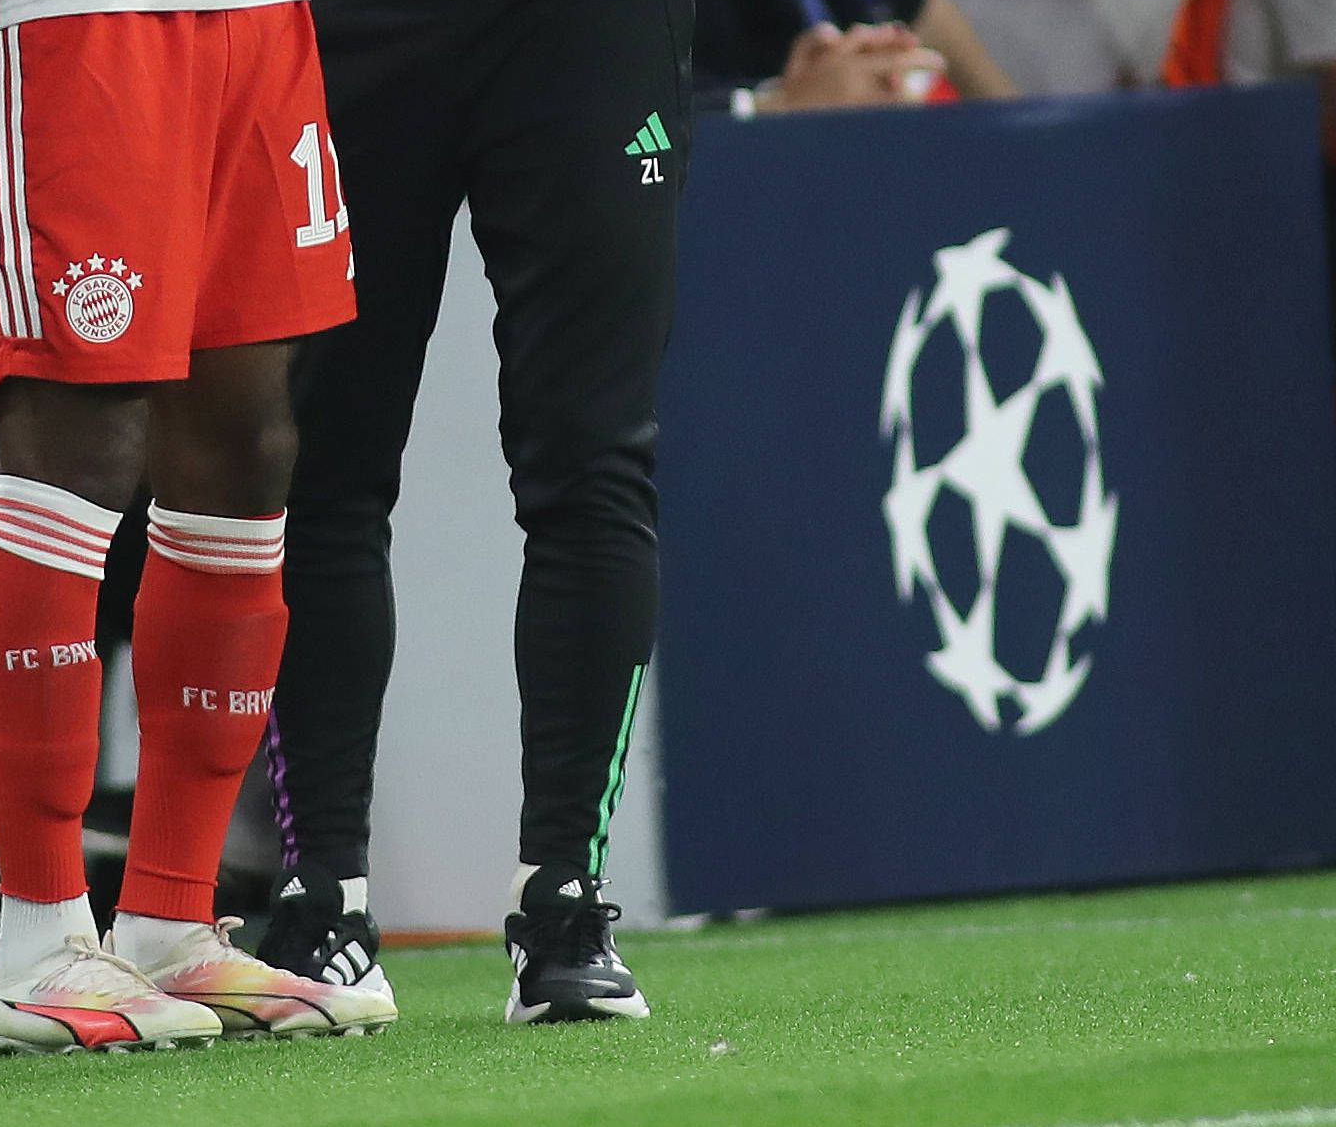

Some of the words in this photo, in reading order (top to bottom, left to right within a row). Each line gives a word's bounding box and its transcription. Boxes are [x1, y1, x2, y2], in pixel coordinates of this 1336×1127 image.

[640, 157, 665, 185] ZL
[72, 290, 85, 306] FC
[84, 279, 126, 303] BAYERN
[5, 648, 40, 672] FC
[182, 685, 217, 711] FC
